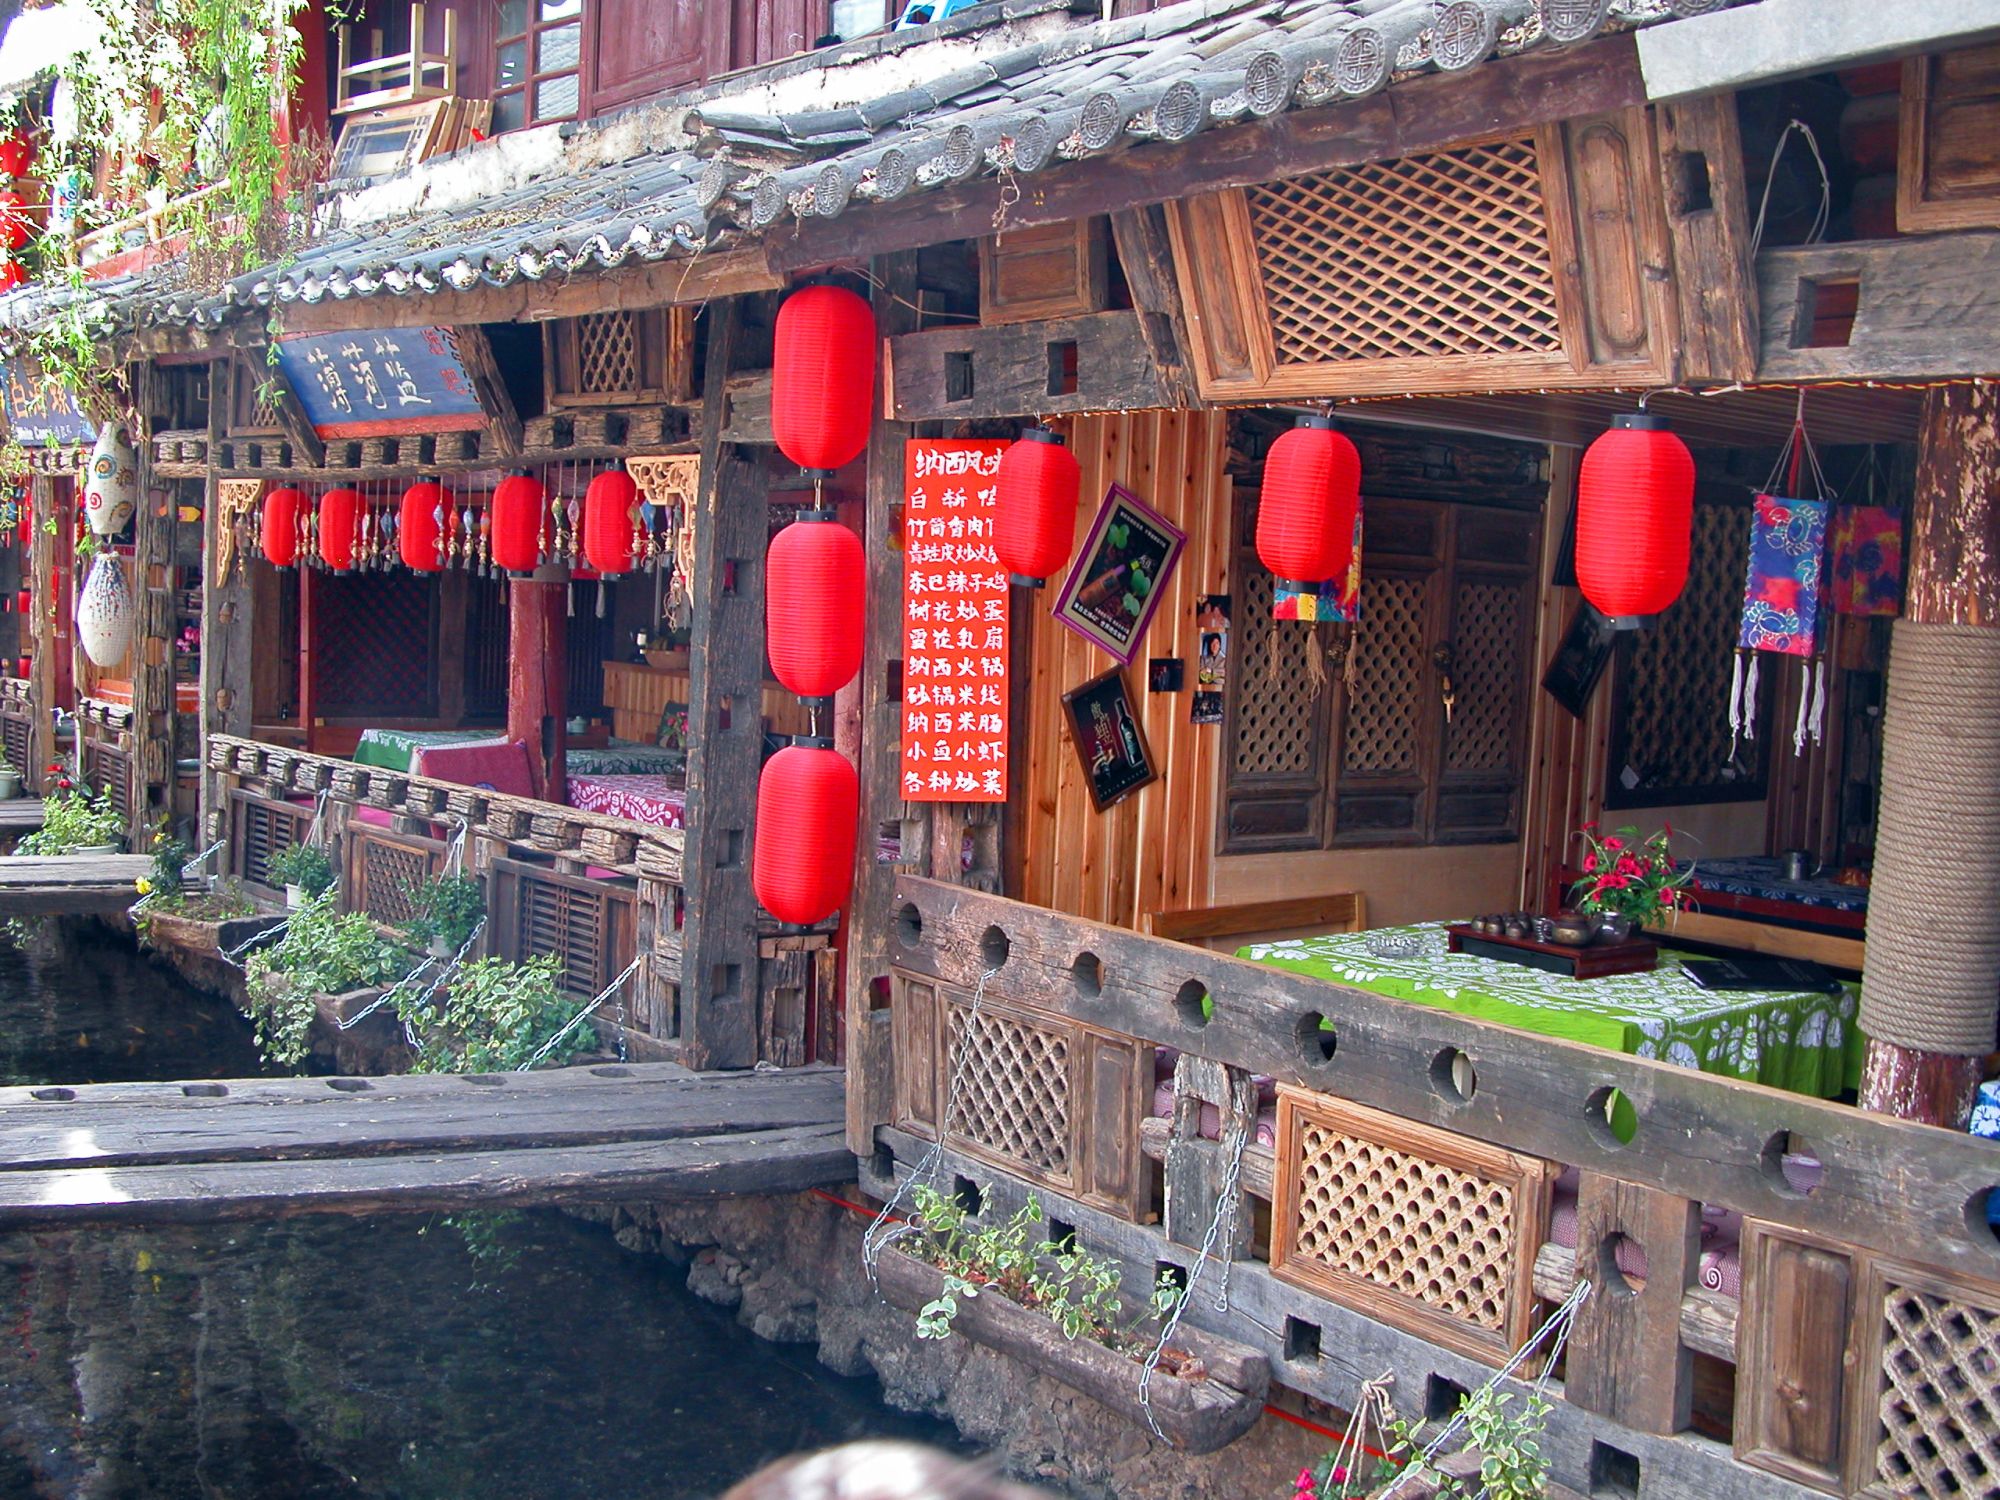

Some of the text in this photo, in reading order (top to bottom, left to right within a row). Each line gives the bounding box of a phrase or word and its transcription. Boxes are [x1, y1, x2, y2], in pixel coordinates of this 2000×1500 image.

[914, 447, 1003, 478] 纳西风味
[907, 655, 1005, 678] 纳西火锅
[906, 683, 1003, 706] 砂锅米线
[906, 739, 1005, 763] 小鱼小虾
[904, 768, 1003, 796] 各种炒菜
